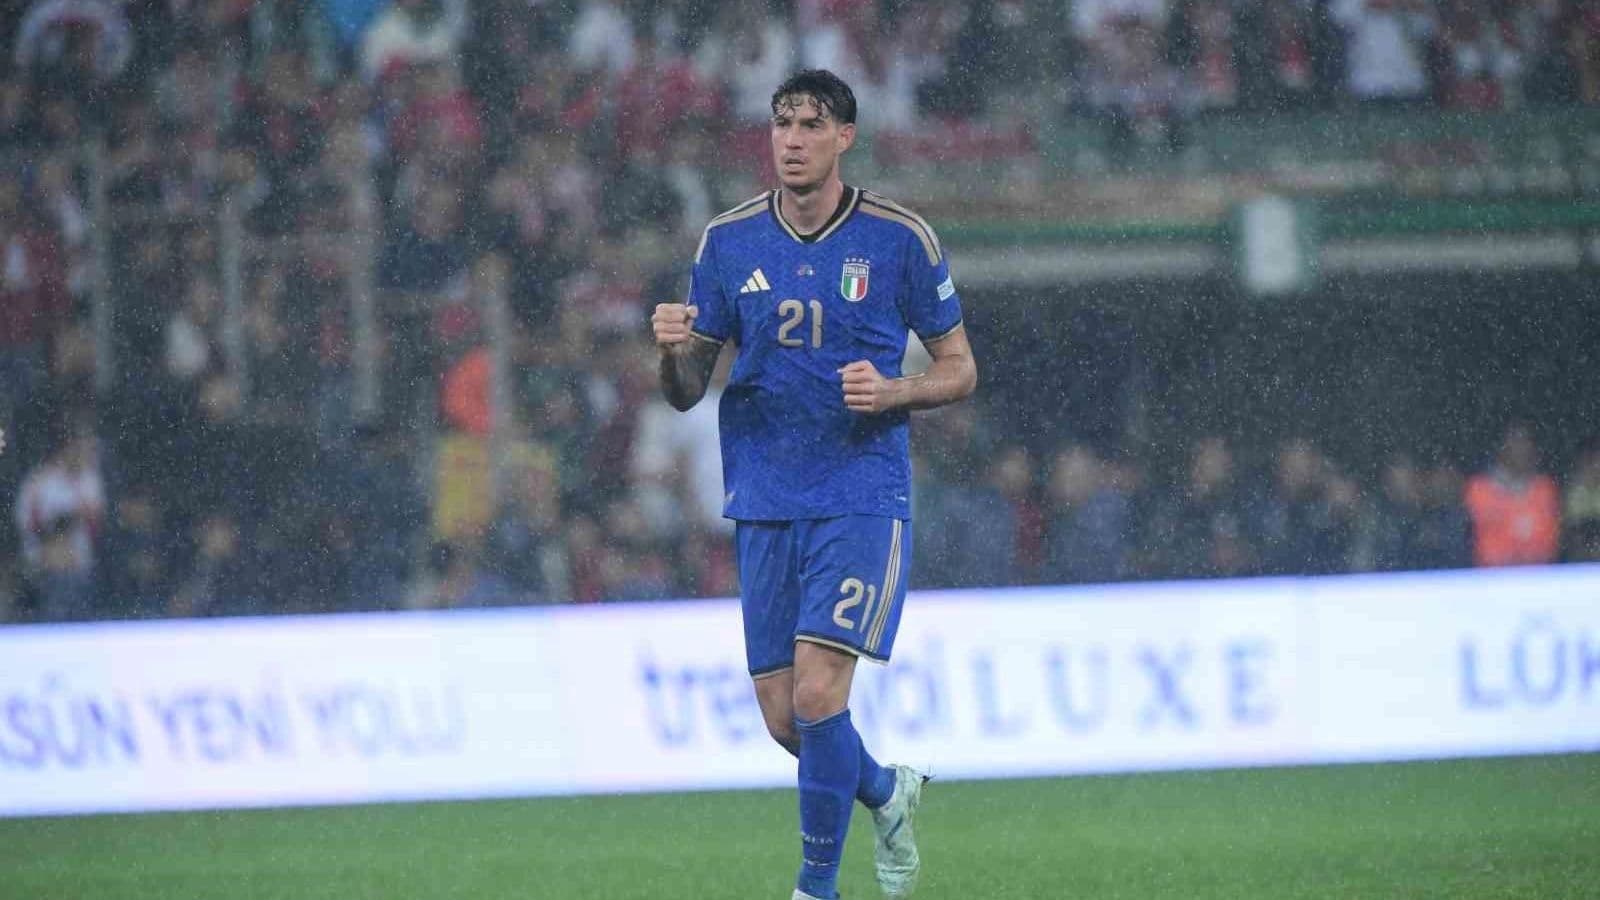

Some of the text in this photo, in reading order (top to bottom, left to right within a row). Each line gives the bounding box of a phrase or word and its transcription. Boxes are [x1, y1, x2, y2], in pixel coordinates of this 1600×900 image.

[778, 298, 823, 348] 21
[832, 577, 876, 634] 21
[0, 668, 141, 771] SÜN
[968, 635, 1281, 740] LUXE
